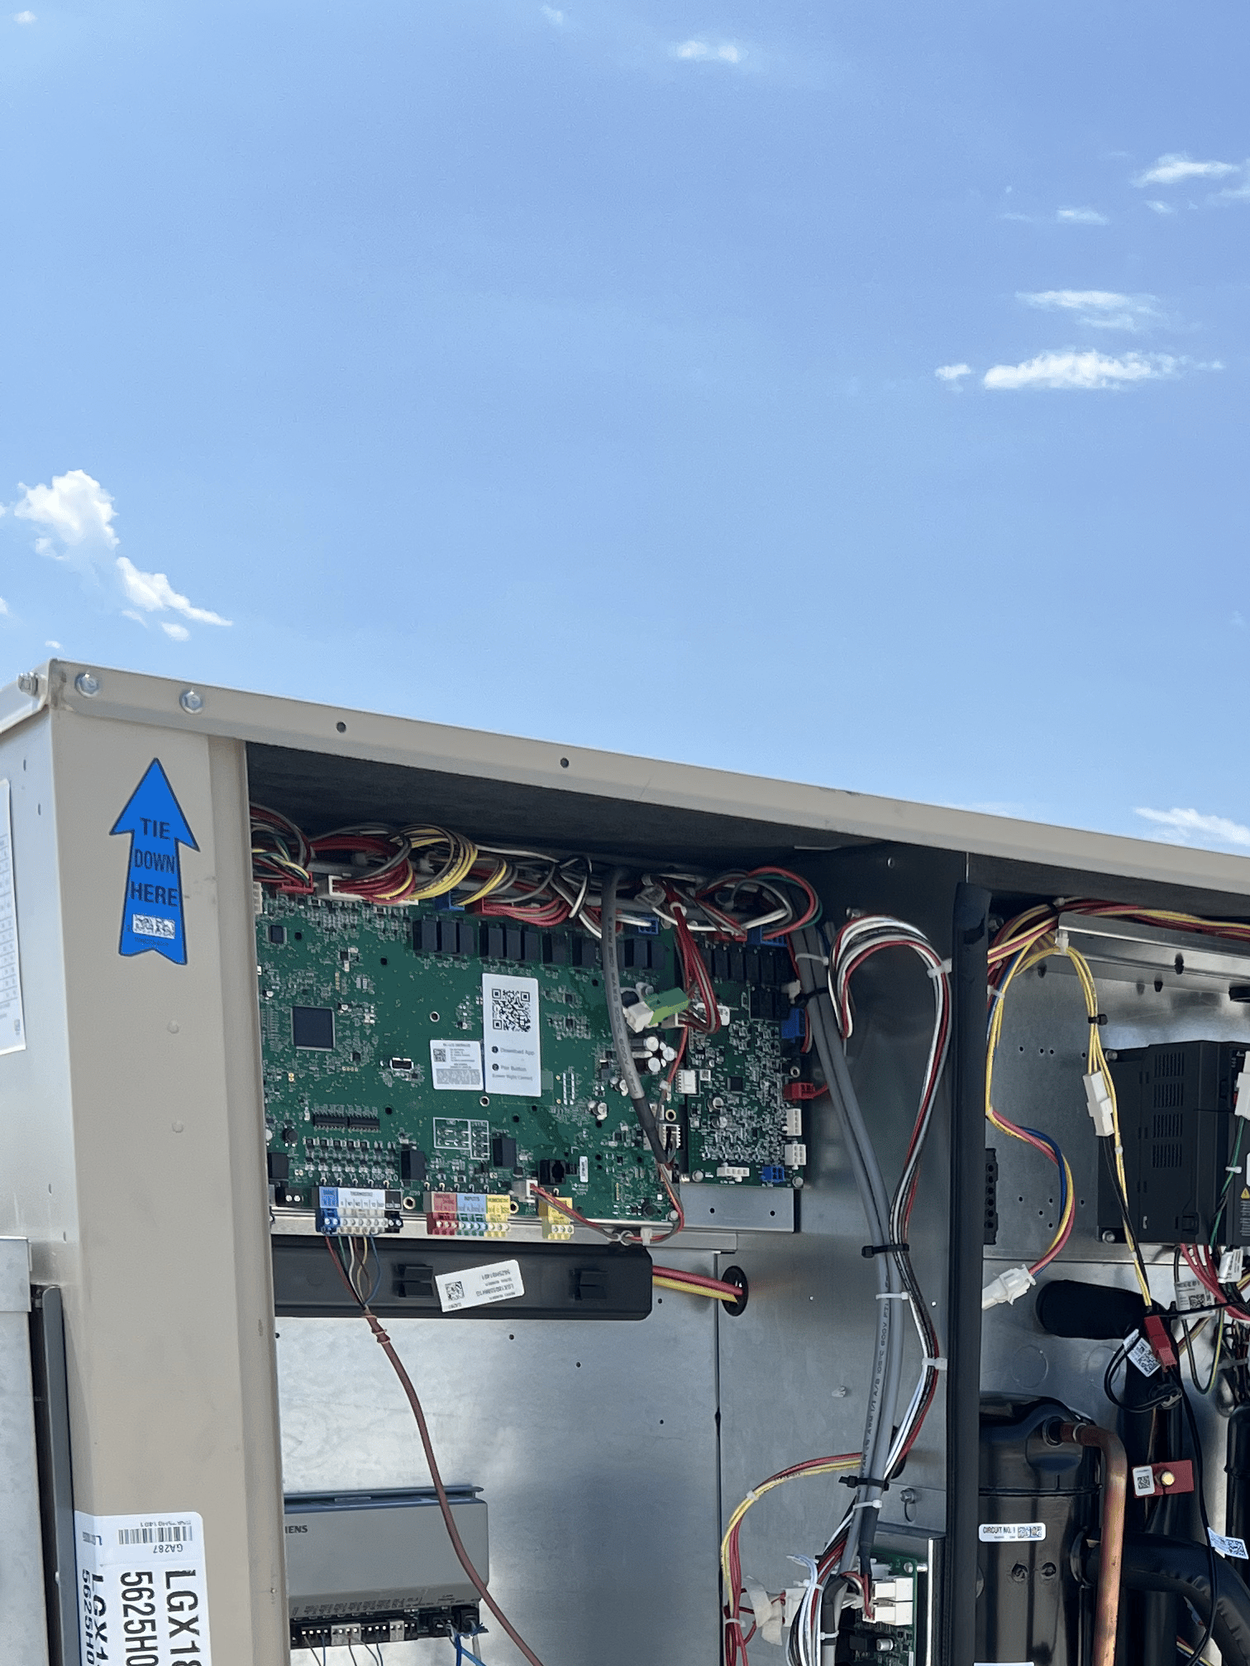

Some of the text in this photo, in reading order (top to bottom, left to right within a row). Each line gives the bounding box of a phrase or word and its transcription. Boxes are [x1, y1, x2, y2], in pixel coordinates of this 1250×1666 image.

[139, 817, 171, 840] TIE
[134, 848, 176, 875] DOWN
[130, 881, 178, 908] HERE
[153, 1543, 184, 1554] GA287
